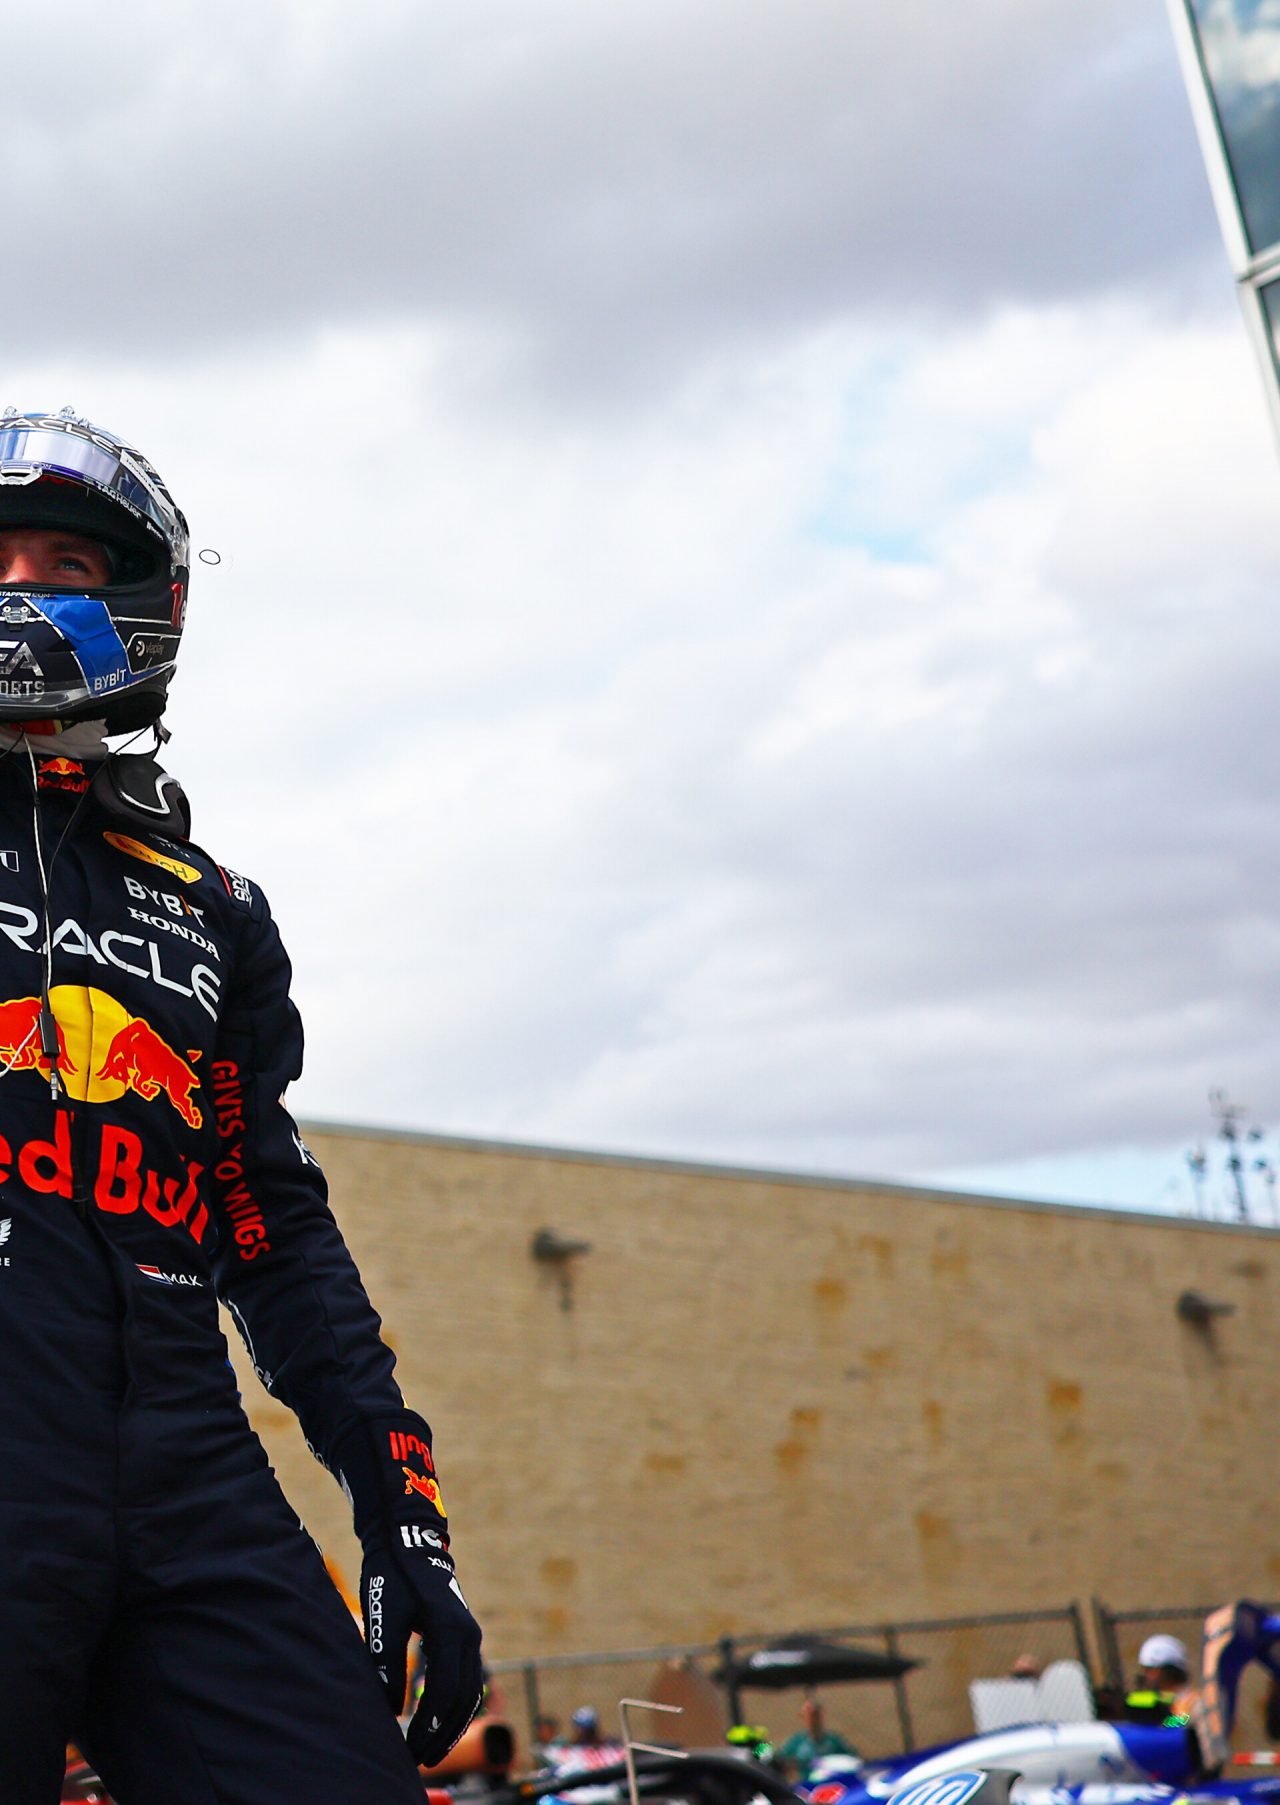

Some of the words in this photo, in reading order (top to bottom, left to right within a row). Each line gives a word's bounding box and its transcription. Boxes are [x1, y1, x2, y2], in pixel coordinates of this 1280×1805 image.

[94, 668, 127, 691] BYBIT
[123, 876, 205, 929] BYBIT
[127, 906, 221, 962] HONDA
[211, 1060, 246, 1138] GIVES
[369, 1575, 385, 1654] sparco
